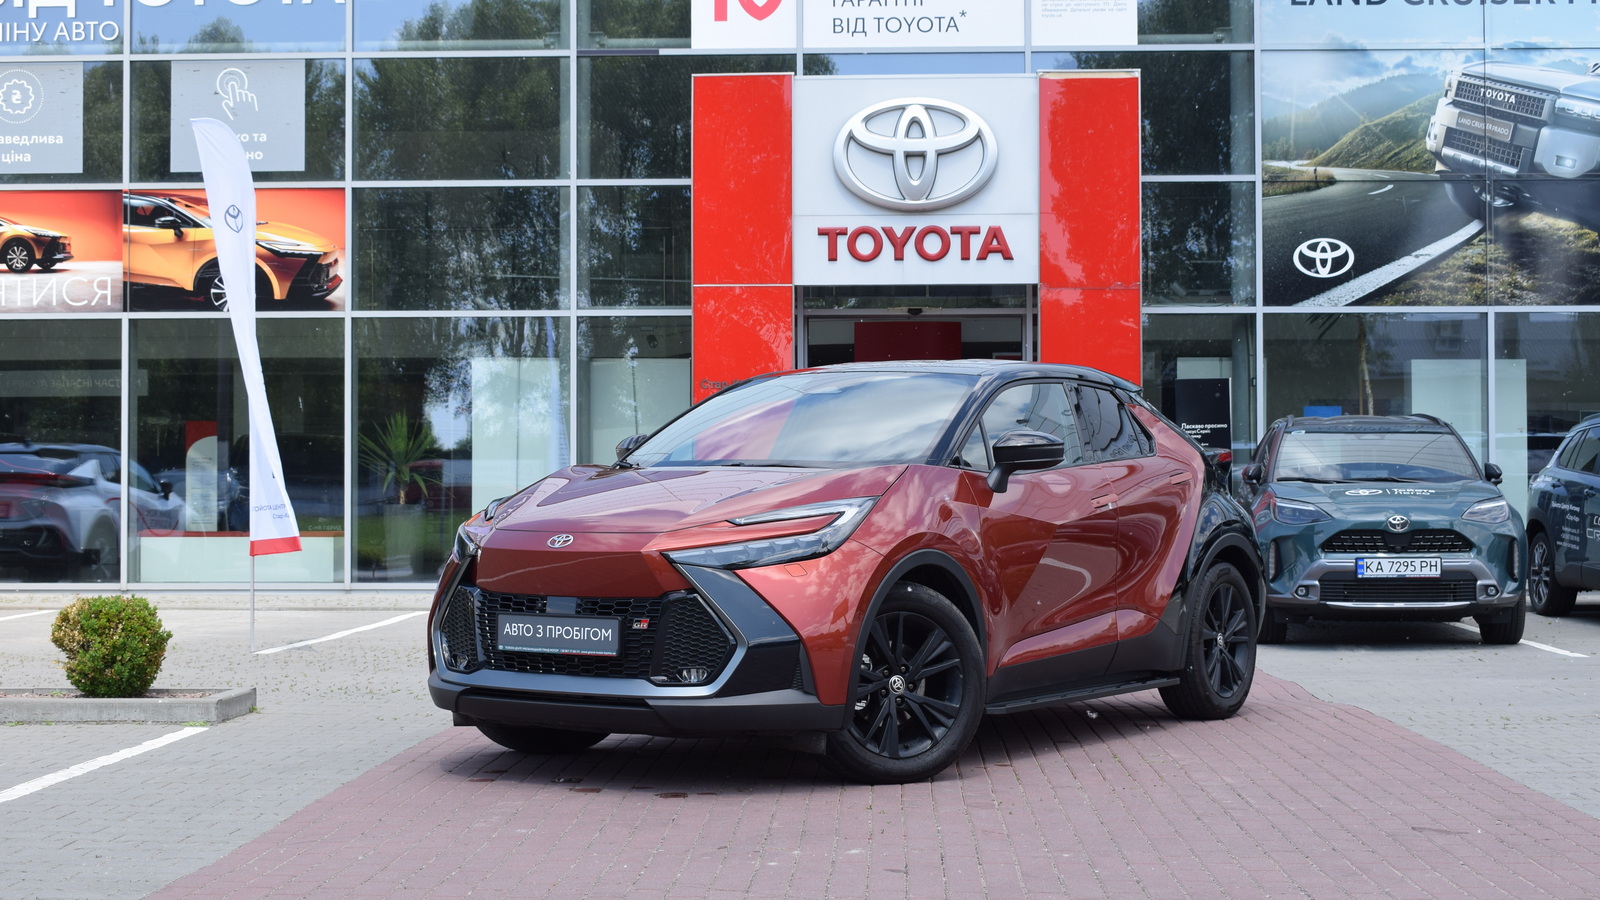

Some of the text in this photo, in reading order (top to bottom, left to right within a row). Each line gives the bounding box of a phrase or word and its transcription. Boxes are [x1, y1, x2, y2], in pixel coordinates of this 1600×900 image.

[53, 21, 119, 41] АВТО
[832, 17, 867, 37] ВІД
[1480, 88, 1516, 104] TOYOTA
[252, 133, 267, 142] та
[1, 150, 32, 164] ціна
[817, 224, 1014, 262] TOYOTA
[1365, 560, 1438, 573] KA 7295 PH
[504, 622, 534, 637] АВТО
[546, 626, 612, 641] ПРОБІГОМ
